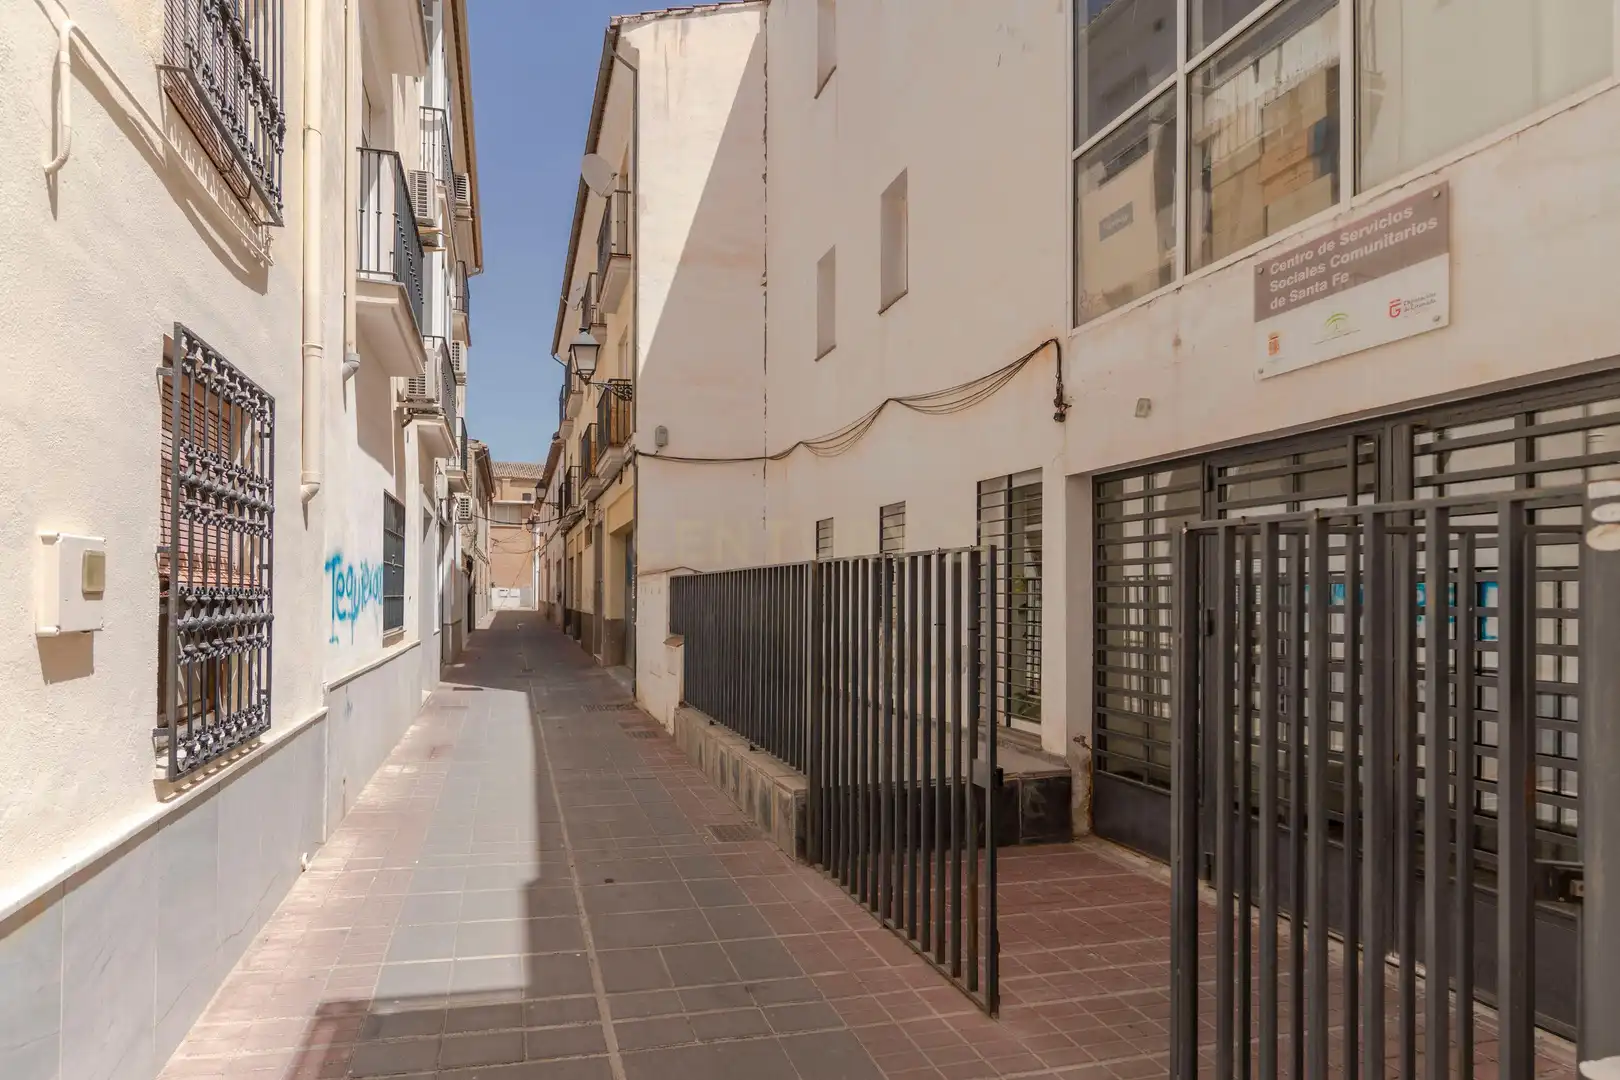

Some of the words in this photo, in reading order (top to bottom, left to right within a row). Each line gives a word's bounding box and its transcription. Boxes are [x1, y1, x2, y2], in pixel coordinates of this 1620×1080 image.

[1269, 249, 1314, 276] Centro
[1318, 240, 1336, 256] de
[1339, 206, 1414, 246] Servicios
[1269, 262, 1326, 292] Sociales
[1330, 217, 1438, 268] Comunitarios
[1270, 294, 1286, 310] de
[1289, 279, 1328, 302] Santa
[1332, 271, 1350, 287] Fe
